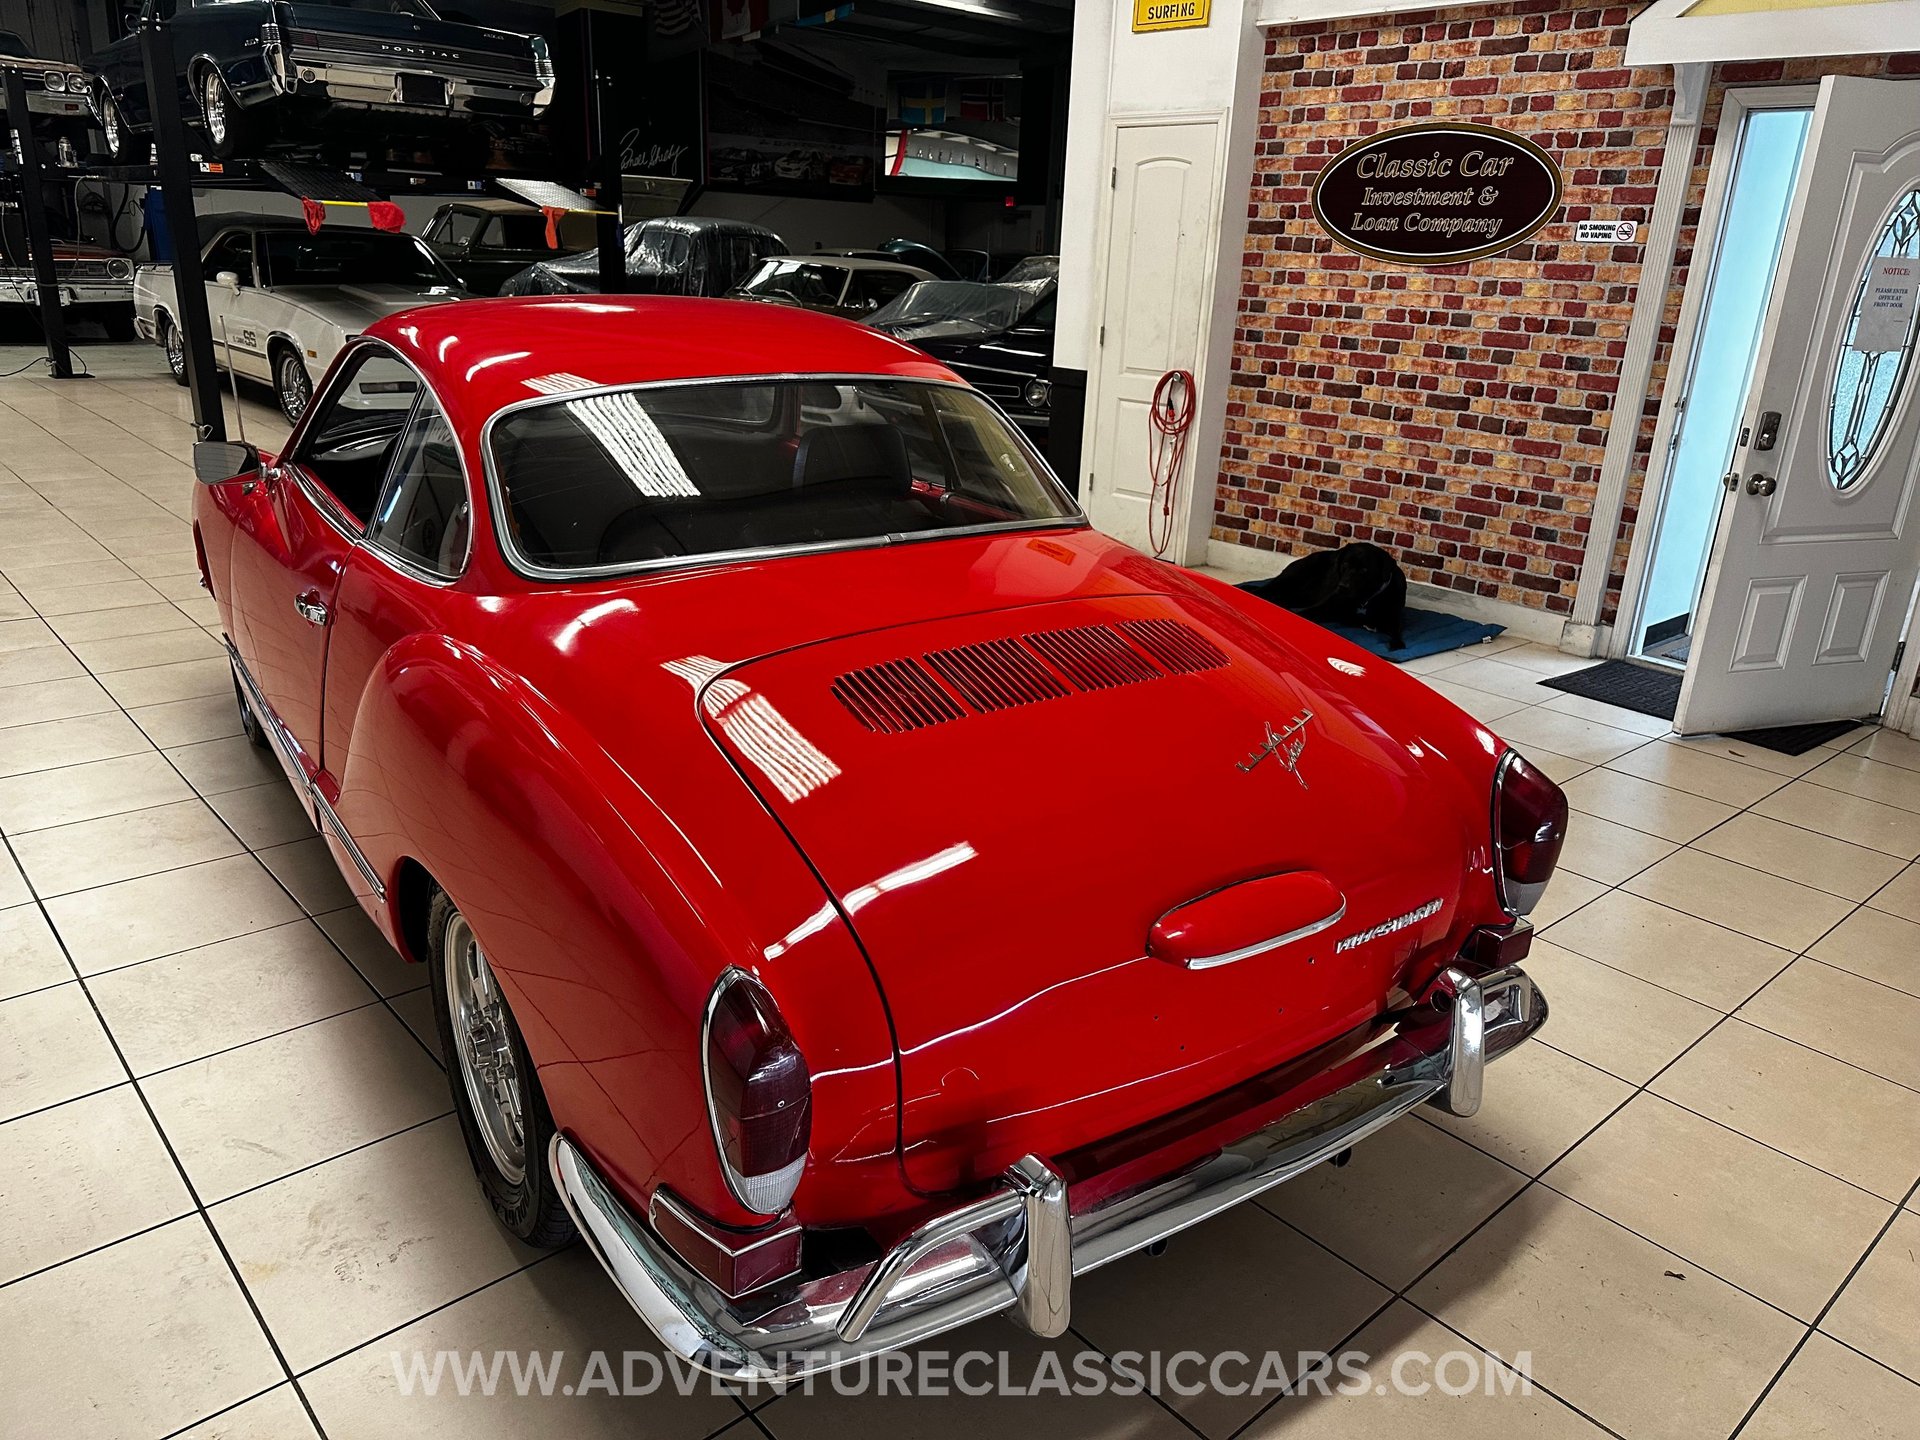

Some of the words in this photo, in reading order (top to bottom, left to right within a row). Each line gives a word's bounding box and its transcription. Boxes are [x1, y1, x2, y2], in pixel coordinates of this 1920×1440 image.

[1147, 2, 1195, 20] SURFING
[381, 44, 461, 59] PONTIAC
[1356, 151, 1452, 179] Classic
[1459, 150, 1514, 177] Car
[1361, 187, 1474, 206] Investment
[1478, 185, 1499, 206] &
[1351, 212, 1398, 232] Loan
[1403, 212, 1503, 238] Company
[1588, 224, 1616, 232] SMOKING
[1882, 267, 1911, 276] NOTICE:
[243, 329, 257, 348] SS
